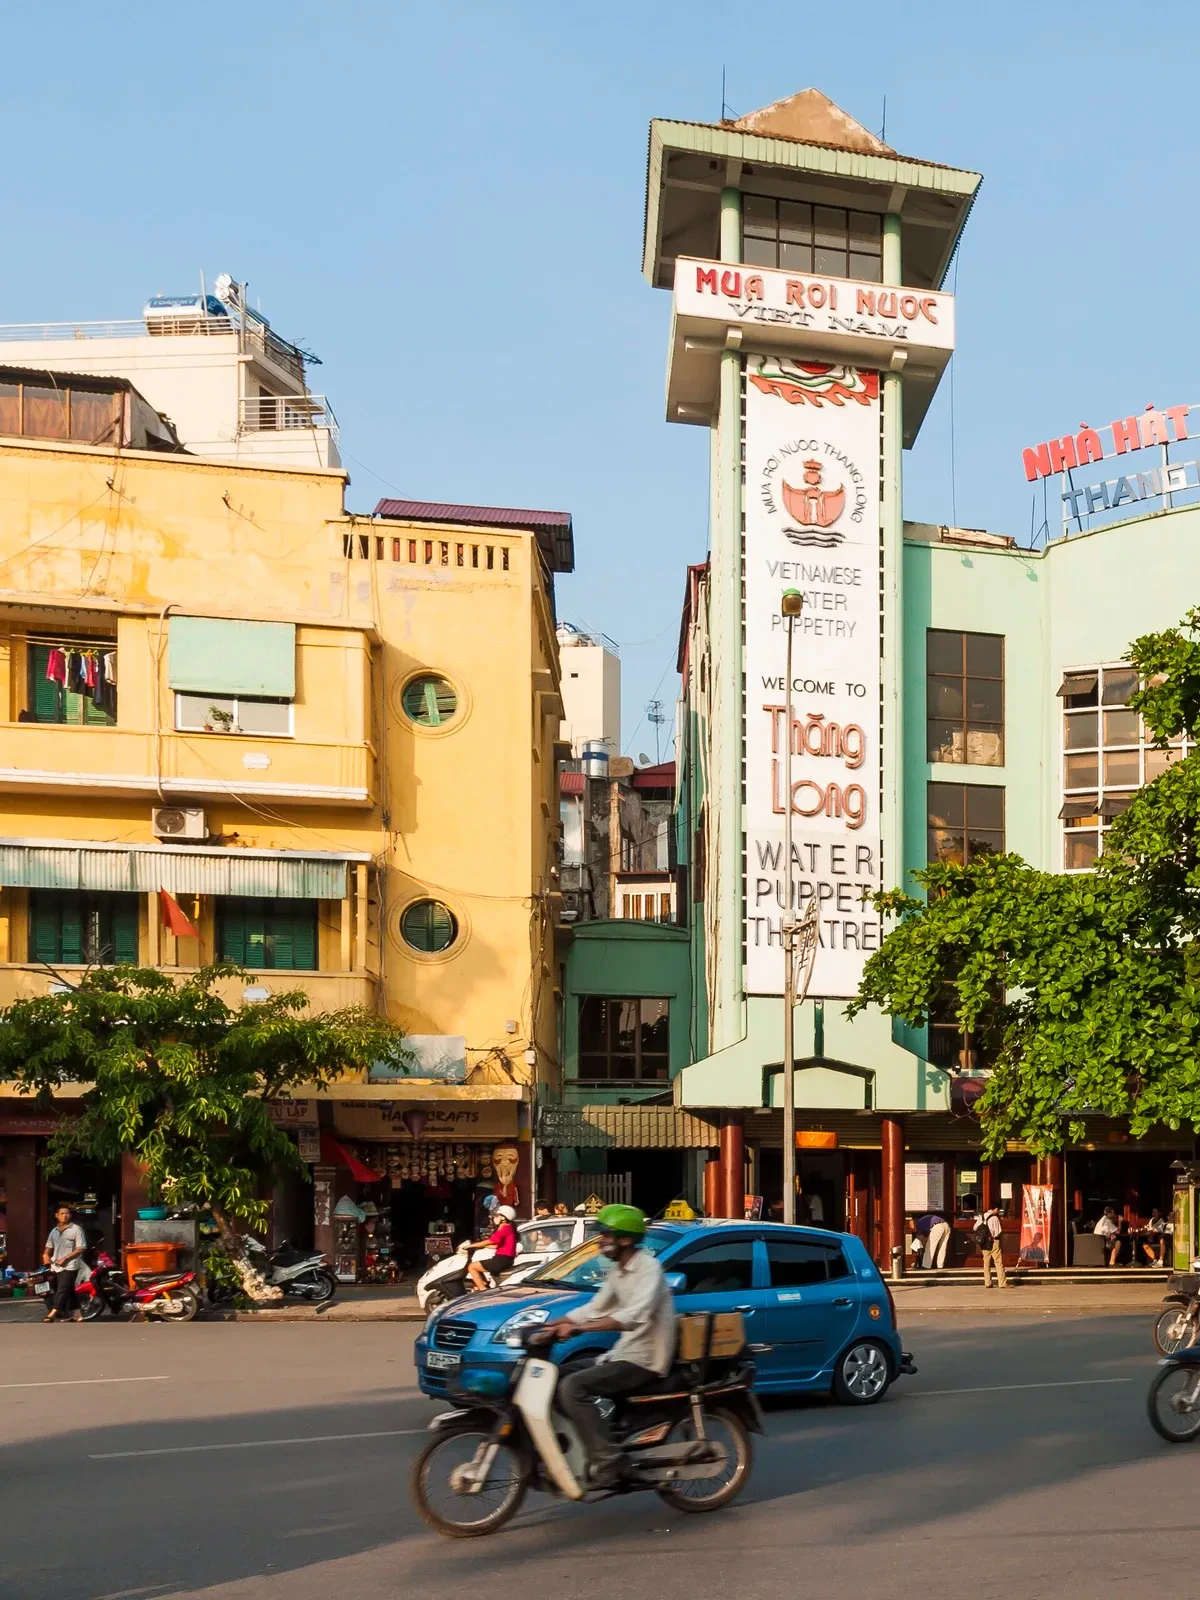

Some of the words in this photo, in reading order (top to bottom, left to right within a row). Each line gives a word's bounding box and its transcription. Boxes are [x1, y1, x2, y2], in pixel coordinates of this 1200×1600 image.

[695, 266, 765, 302] MUA
[785, 279, 838, 311] ROI
[856, 288, 939, 325] NUOC
[728, 302, 816, 327] VIET
[827, 315, 909, 340] NAM
[778, 439, 820, 459] NUOC
[1021, 421, 1104, 482] NHÀ
[1110, 401, 1190, 456] HÁT
[762, 455, 782, 479] ROI
[823, 441, 864, 484] THANG
[760, 482, 778, 515] MUA
[849, 485, 868, 524] LONG
[1061, 462, 1188, 517] THANG
[765, 559, 863, 587] VIETNAMESE
[781, 588, 849, 612] ATER
[761, 676, 836, 696] WECOME
[845, 682, 867, 698] TO
[762, 704, 866, 769] Thăng
[771, 758, 866, 830] Long
[754, 839, 876, 876] WATER
[755, 877, 874, 914] PUPPET
[665, 1210, 686, 1218] TAXI
